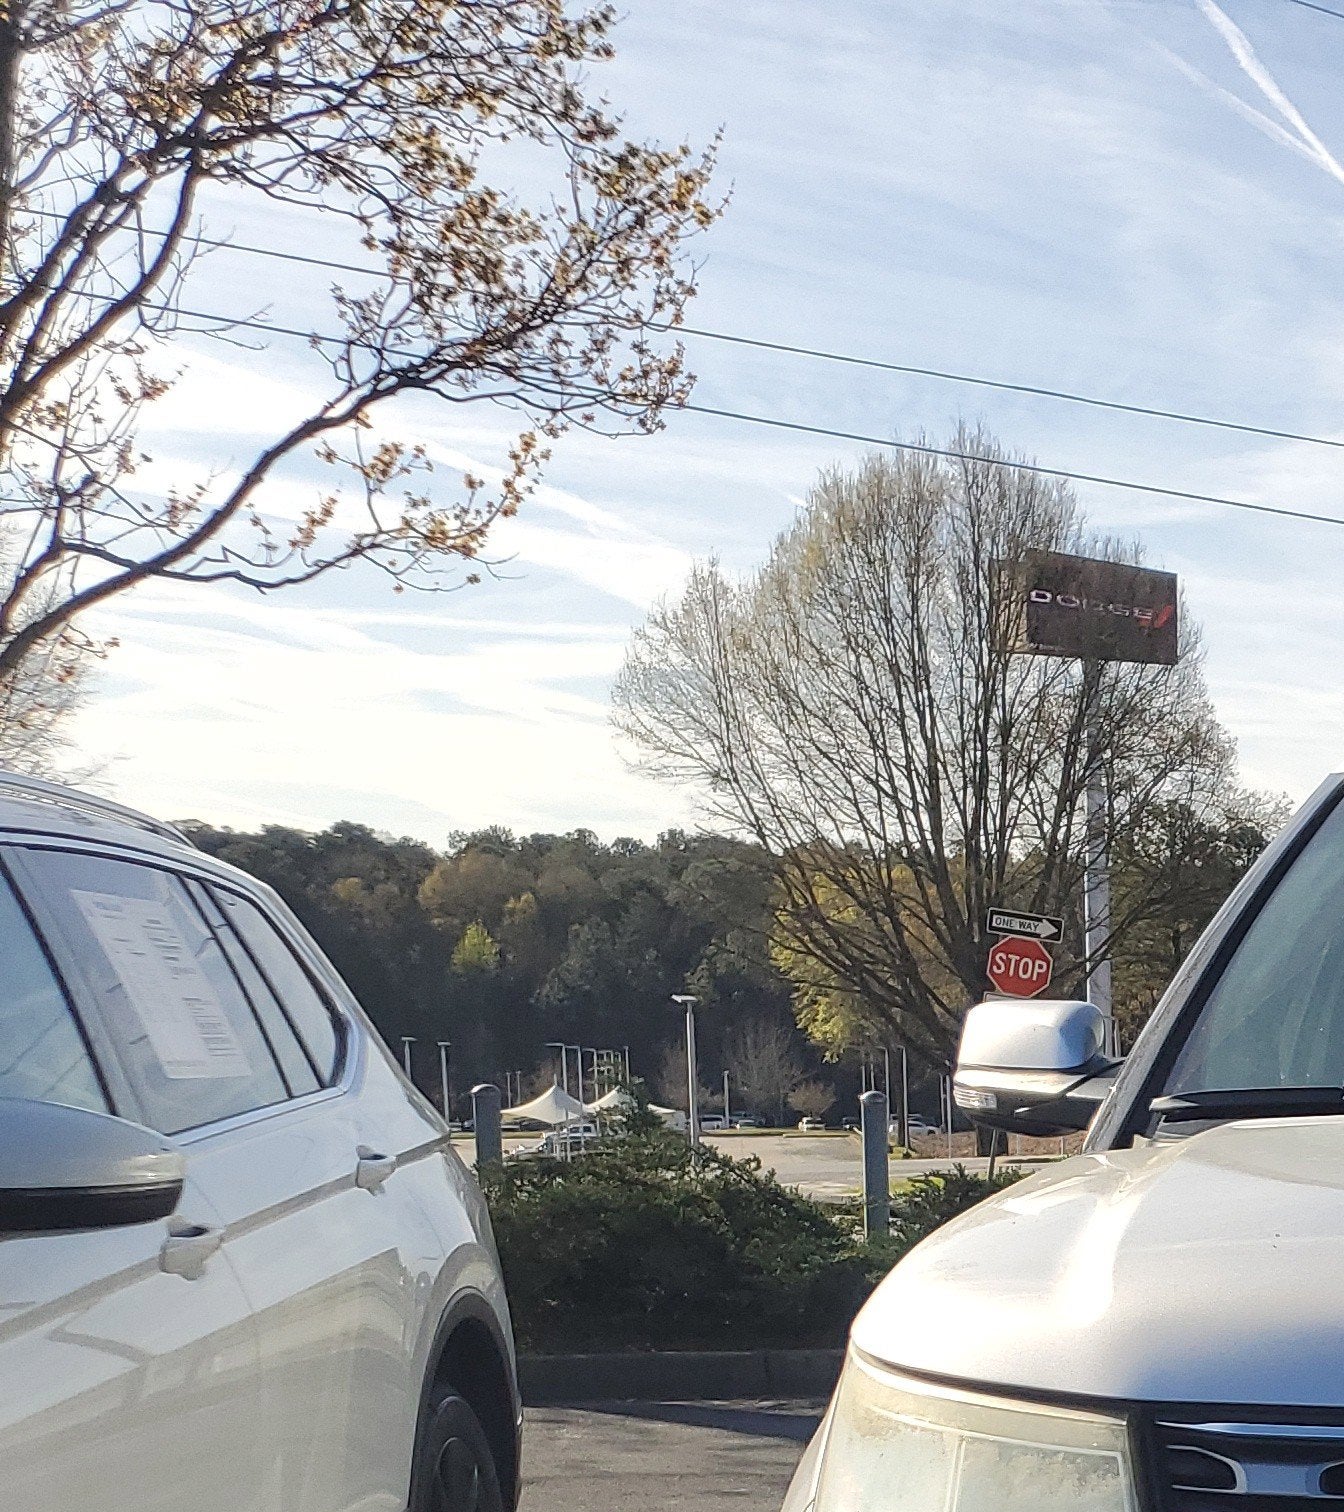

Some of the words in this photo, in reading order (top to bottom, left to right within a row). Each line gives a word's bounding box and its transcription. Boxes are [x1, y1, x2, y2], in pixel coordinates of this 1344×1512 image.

[994, 916, 1015, 928] ONE
[1018, 920, 1040, 931] WAY
[992, 952, 1047, 981] STOP
